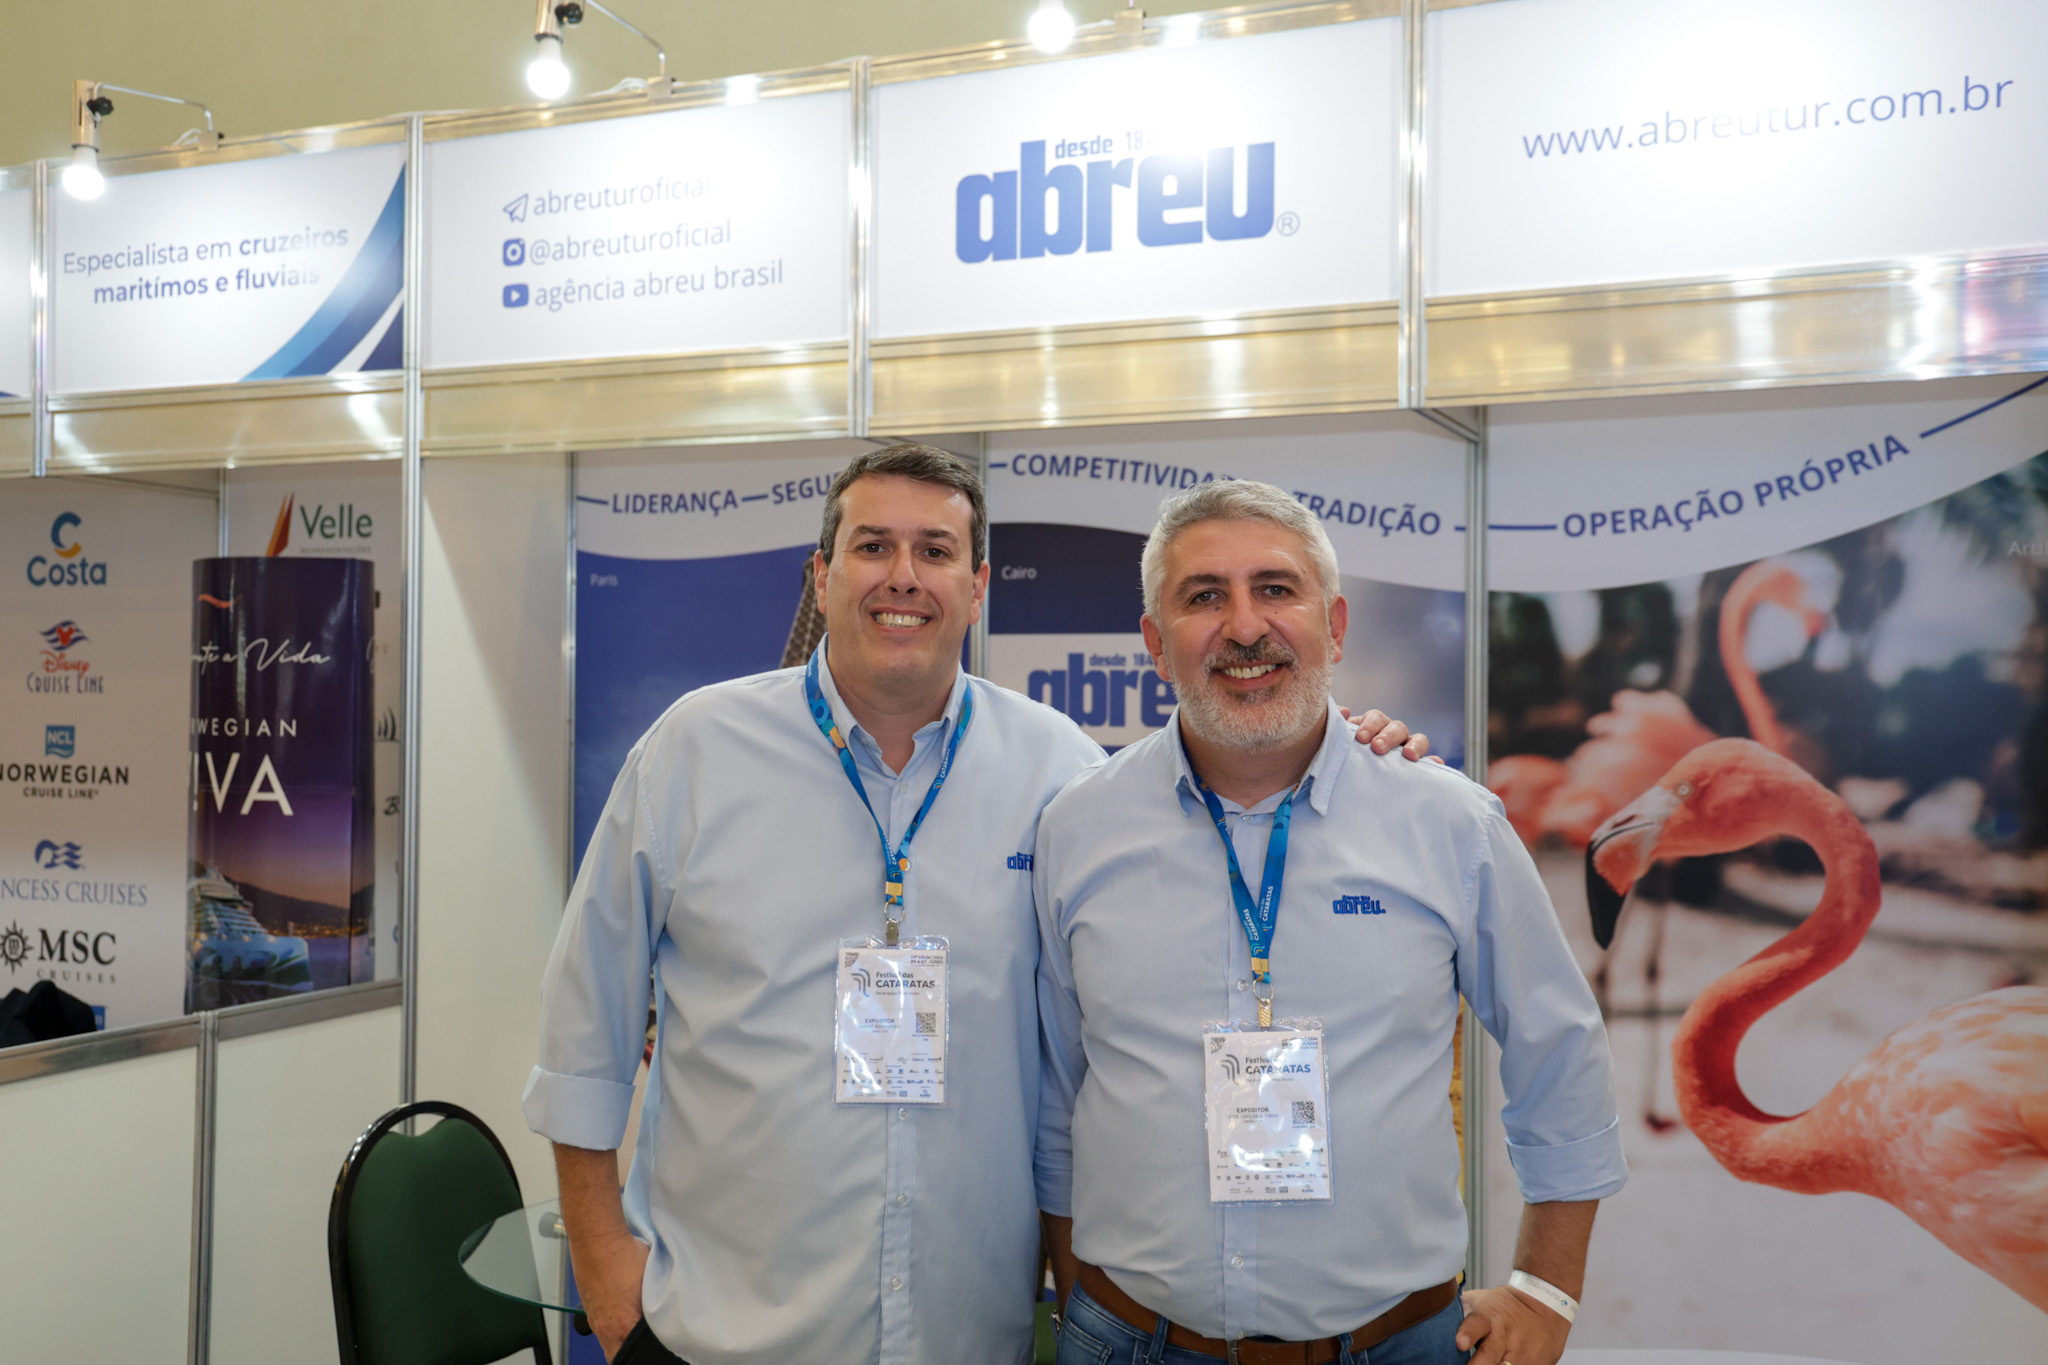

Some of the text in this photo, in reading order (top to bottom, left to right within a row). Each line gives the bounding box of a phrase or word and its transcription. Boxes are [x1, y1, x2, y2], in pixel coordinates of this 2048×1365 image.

[1523, 76, 2013, 158] www.abreutur.com.br
[1055, 134, 1113, 159] desde
[533, 172, 711, 216] abreuturoficial
[956, 140, 1275, 264] abreu
[63, 226, 349, 277] Especialista em cruzeiros
[529, 219, 731, 266] @abreuturoficial
[94, 264, 320, 304] maritímos e fluviais
[535, 259, 783, 312] agência abreu brasil
[772, 471, 842, 505] SEGU
[1563, 434, 1911, 538] OPERAÇÃO PRÓPRIA
[611, 489, 739, 517] LIDERANÇA
[299, 504, 373, 539] Velle
[27, 556, 107, 586] Costa
[590, 573, 618, 586] Paris
[1001, 566, 1037, 581] Cairo
[40, 650, 90, 677] Disney
[245, 637, 332, 672] Vida
[1089, 654, 1126, 667] desde
[47, 730, 74, 745] NCL
[191, 718, 297, 737] WEGIAN
[23, 787, 64, 798] CRUISE
[65, 881, 148, 906] CRUISES
[1262, 886, 1273, 922] CATARATAS
[1333, 895, 1381, 915] abreu
[38, 928, 116, 966] MSC
[37, 969, 116, 984] CRUISES
[876, 980, 936, 988] CATARATAS
